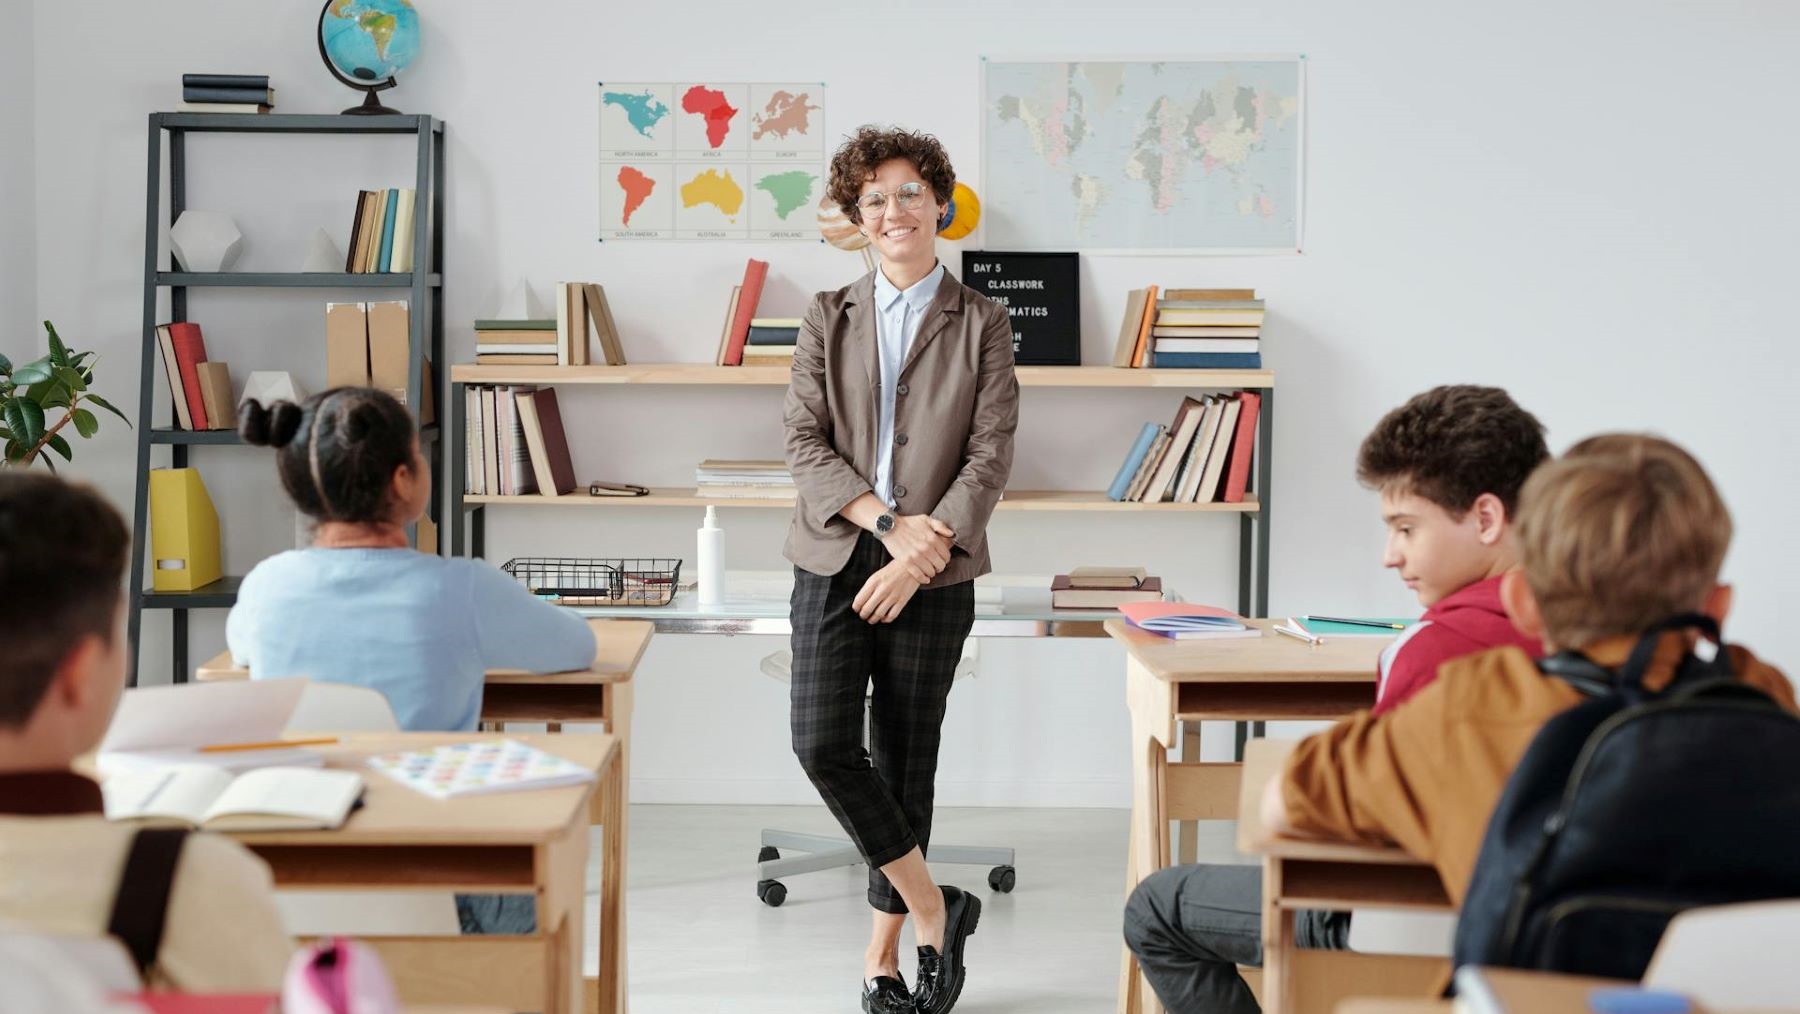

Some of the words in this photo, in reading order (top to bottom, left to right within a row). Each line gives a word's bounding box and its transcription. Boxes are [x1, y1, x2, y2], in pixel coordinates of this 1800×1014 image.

[973, 263, 992, 272] DAY
[995, 263, 1001, 272] 5
[988, 280, 1044, 289] CLASSWORK
[987, 296, 1009, 305] THS
[1006, 307, 1048, 316] MATICS
